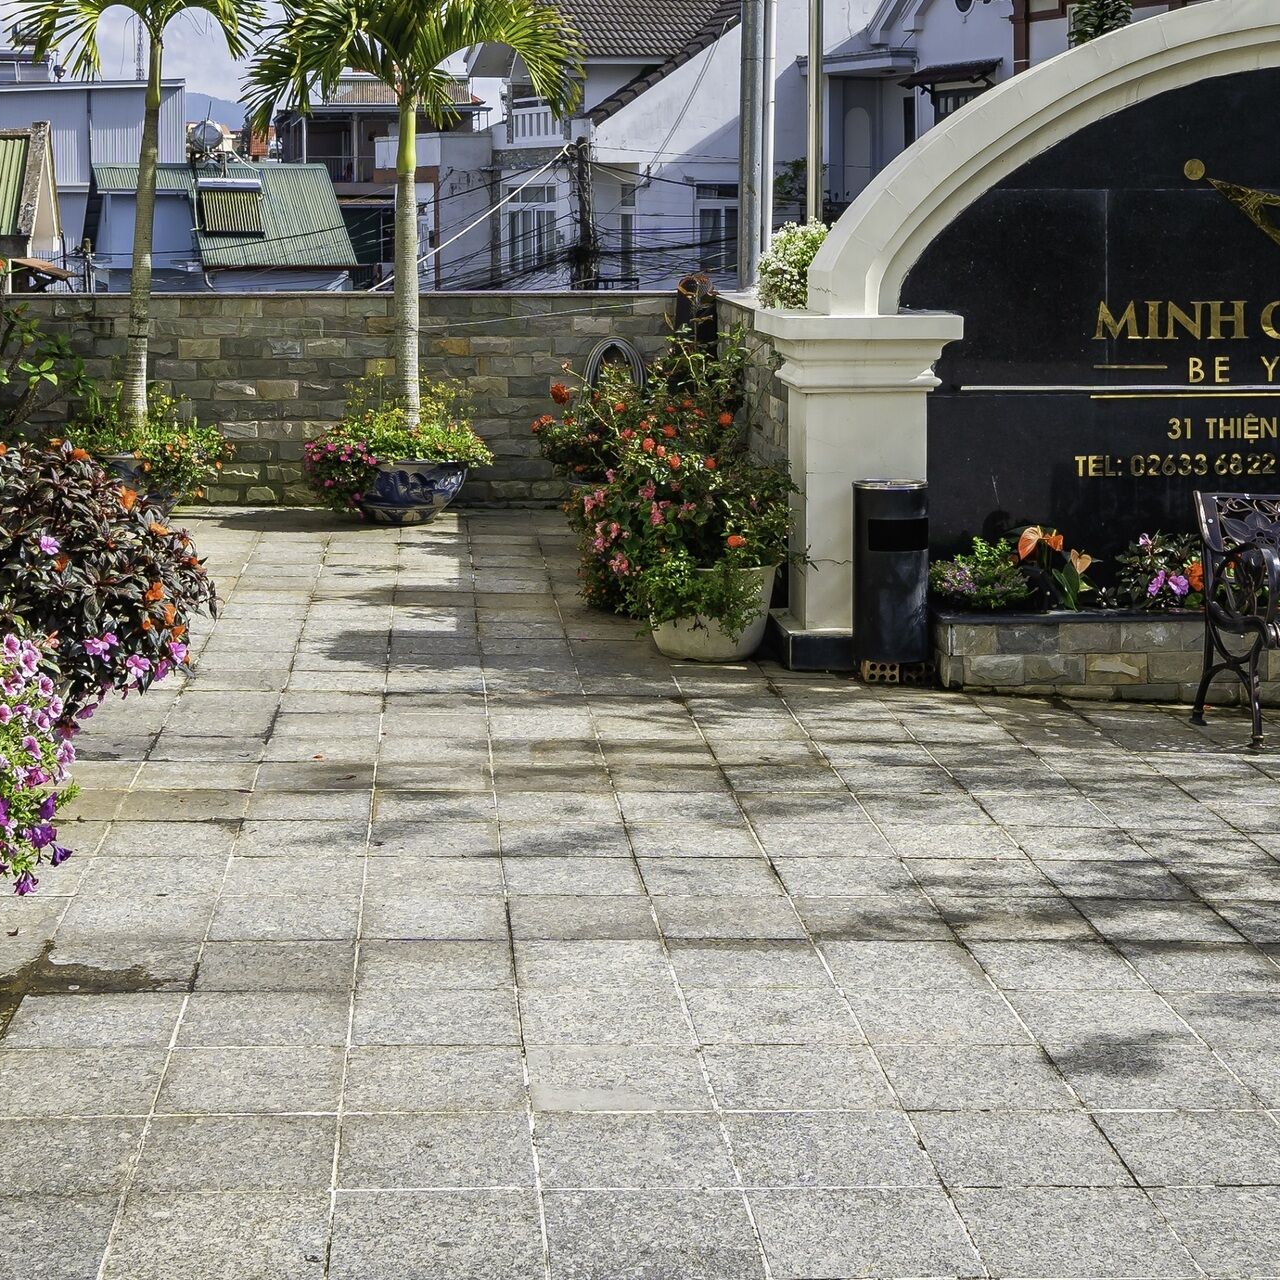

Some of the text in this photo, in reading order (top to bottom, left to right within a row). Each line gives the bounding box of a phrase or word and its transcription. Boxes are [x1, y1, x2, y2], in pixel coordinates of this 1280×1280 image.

[1091, 300, 1249, 340] MINH
[1188, 356, 1230, 383] BE
[1167, 418, 1192, 440] 31
[1205, 413, 1278, 443] THIỆN
[1074, 455, 1123, 477] TEL:
